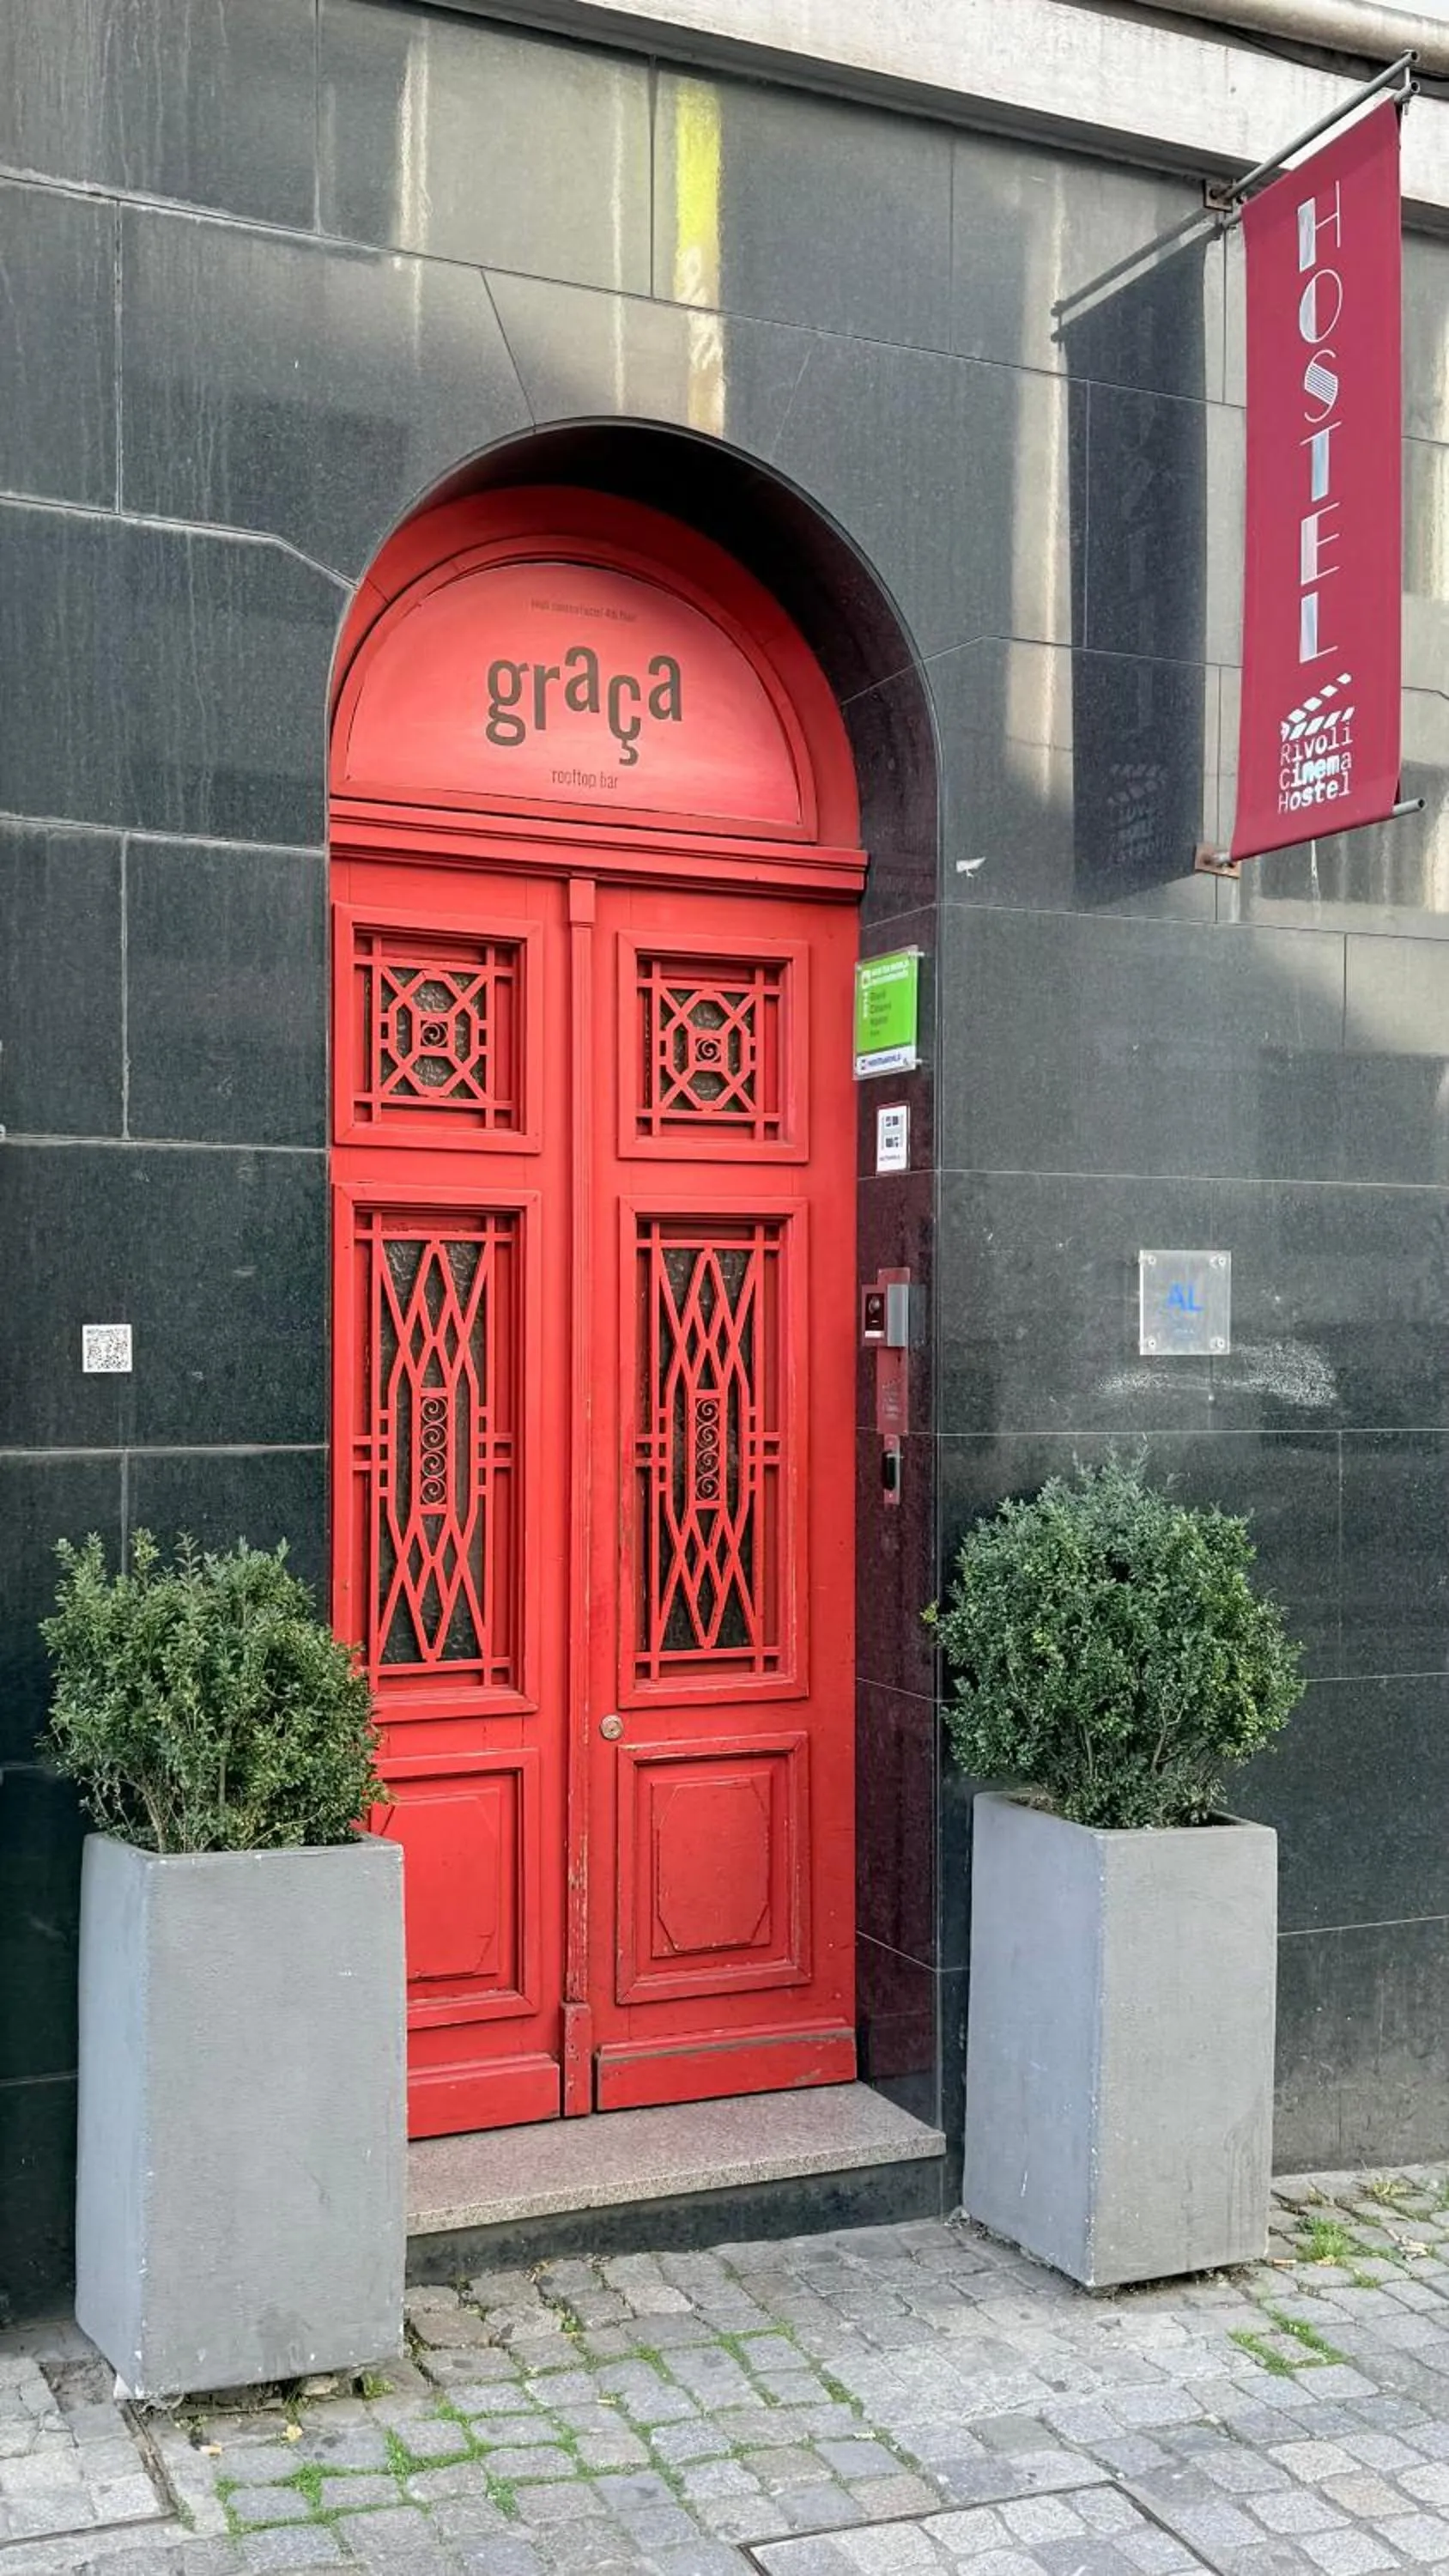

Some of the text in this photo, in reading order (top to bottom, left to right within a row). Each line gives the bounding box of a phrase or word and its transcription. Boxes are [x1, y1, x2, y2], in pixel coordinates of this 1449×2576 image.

[1297, 179, 1343, 664] HOSTEL
[485, 646, 682, 766] graça
[1279, 721, 1354, 766] Rivoli
[552, 769, 618, 789] rooftop bar
[1276, 770, 1351, 814] Hostel
[1278, 751, 1352, 790] Cinema
[1167, 1280, 1204, 1312] AL
